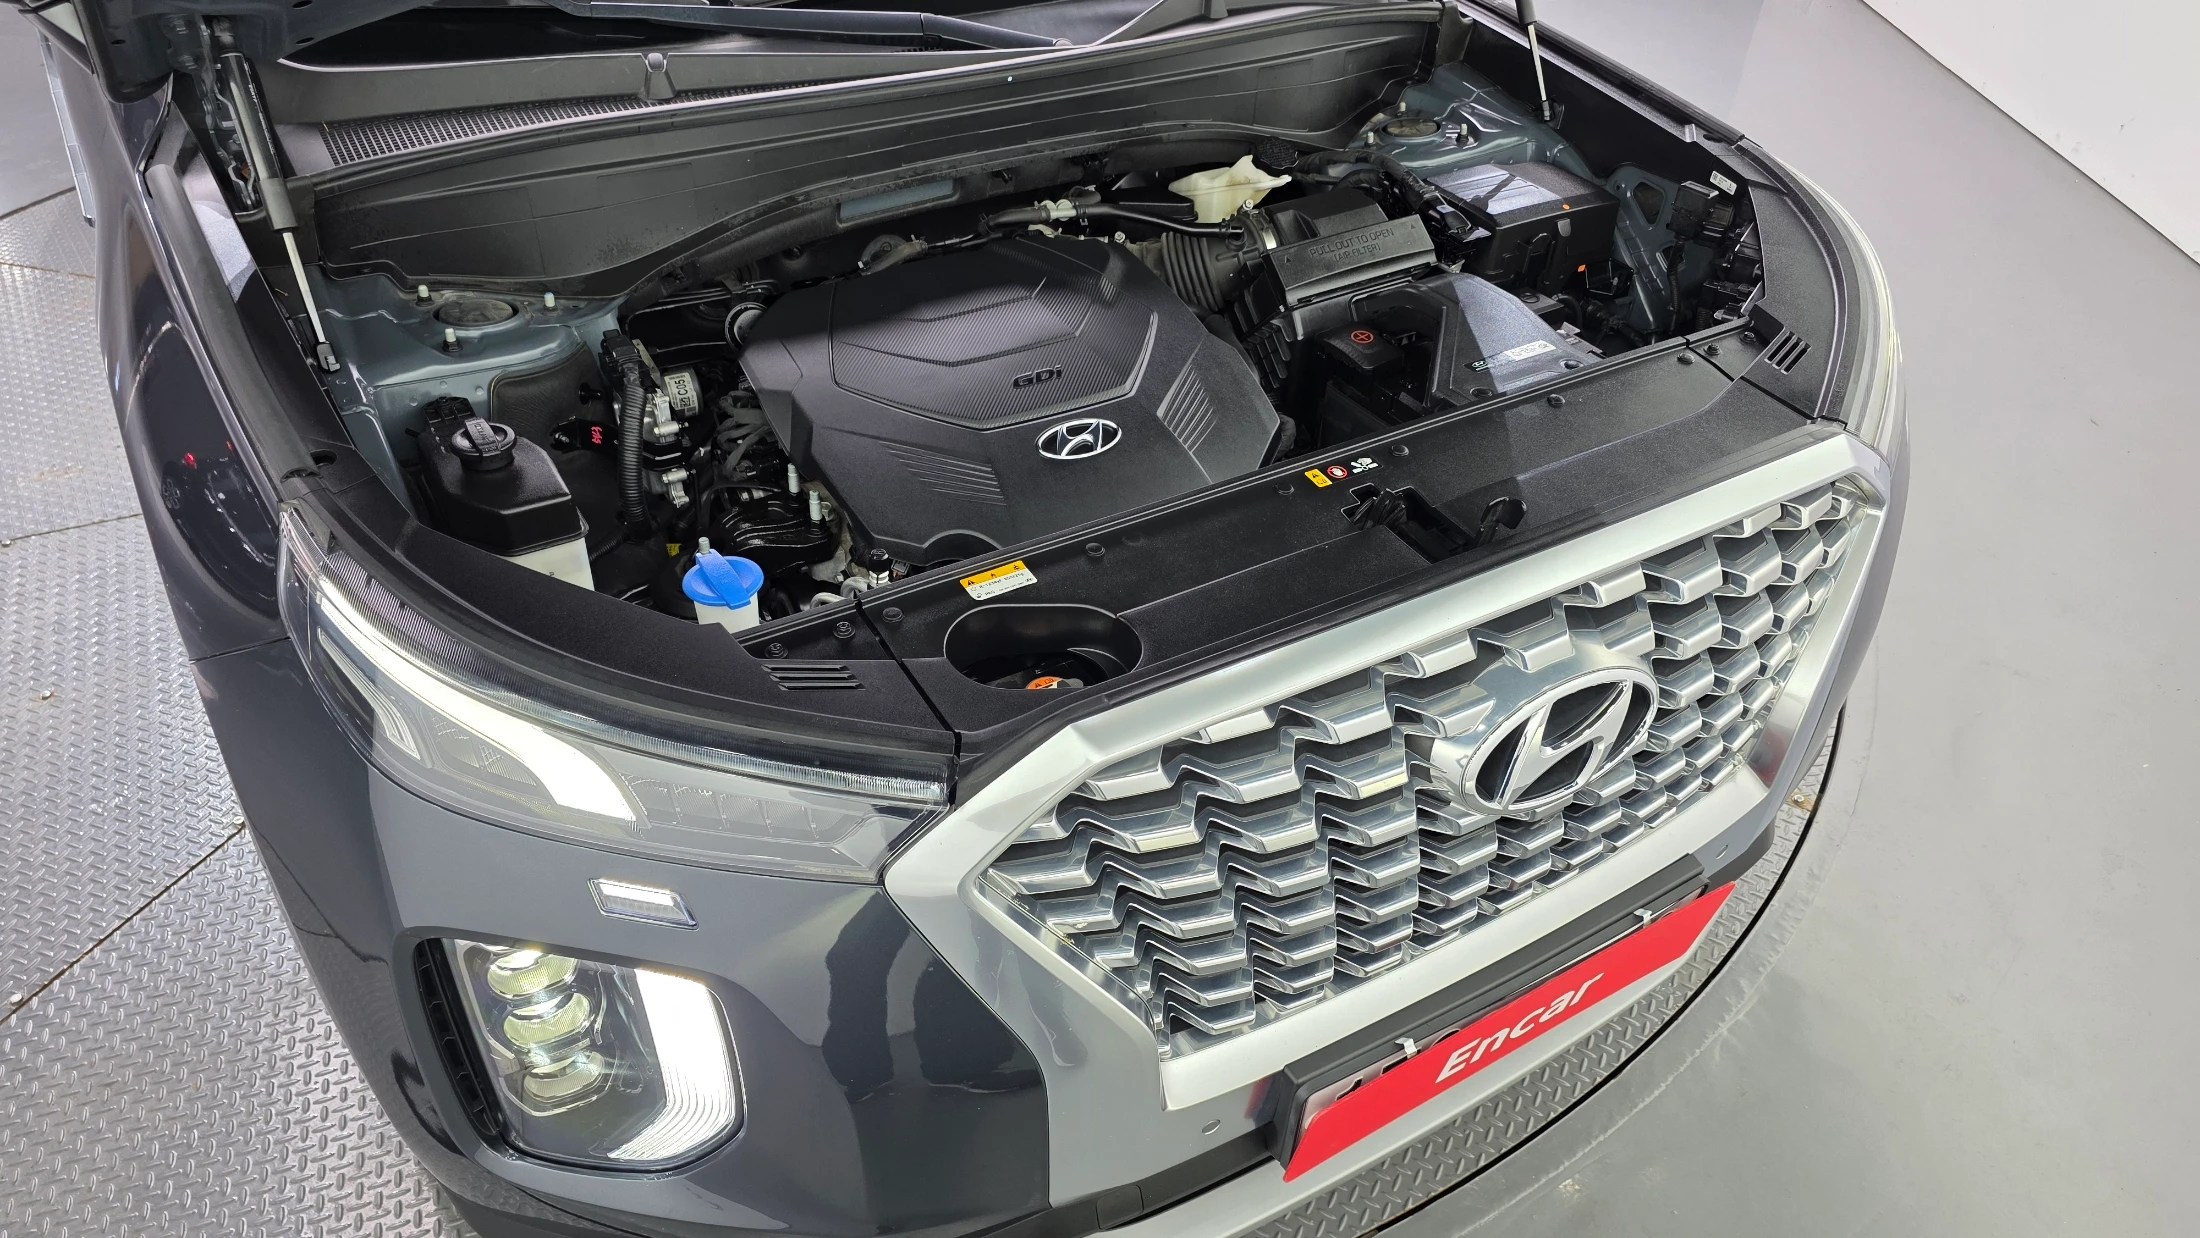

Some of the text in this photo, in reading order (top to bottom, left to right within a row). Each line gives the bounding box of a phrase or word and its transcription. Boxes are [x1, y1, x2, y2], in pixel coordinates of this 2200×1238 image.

[1309, 228, 1394, 258] PULL OUT TO OPEN
[674, 379, 688, 396] C05
[1435, 972, 1605, 1084] Encar
